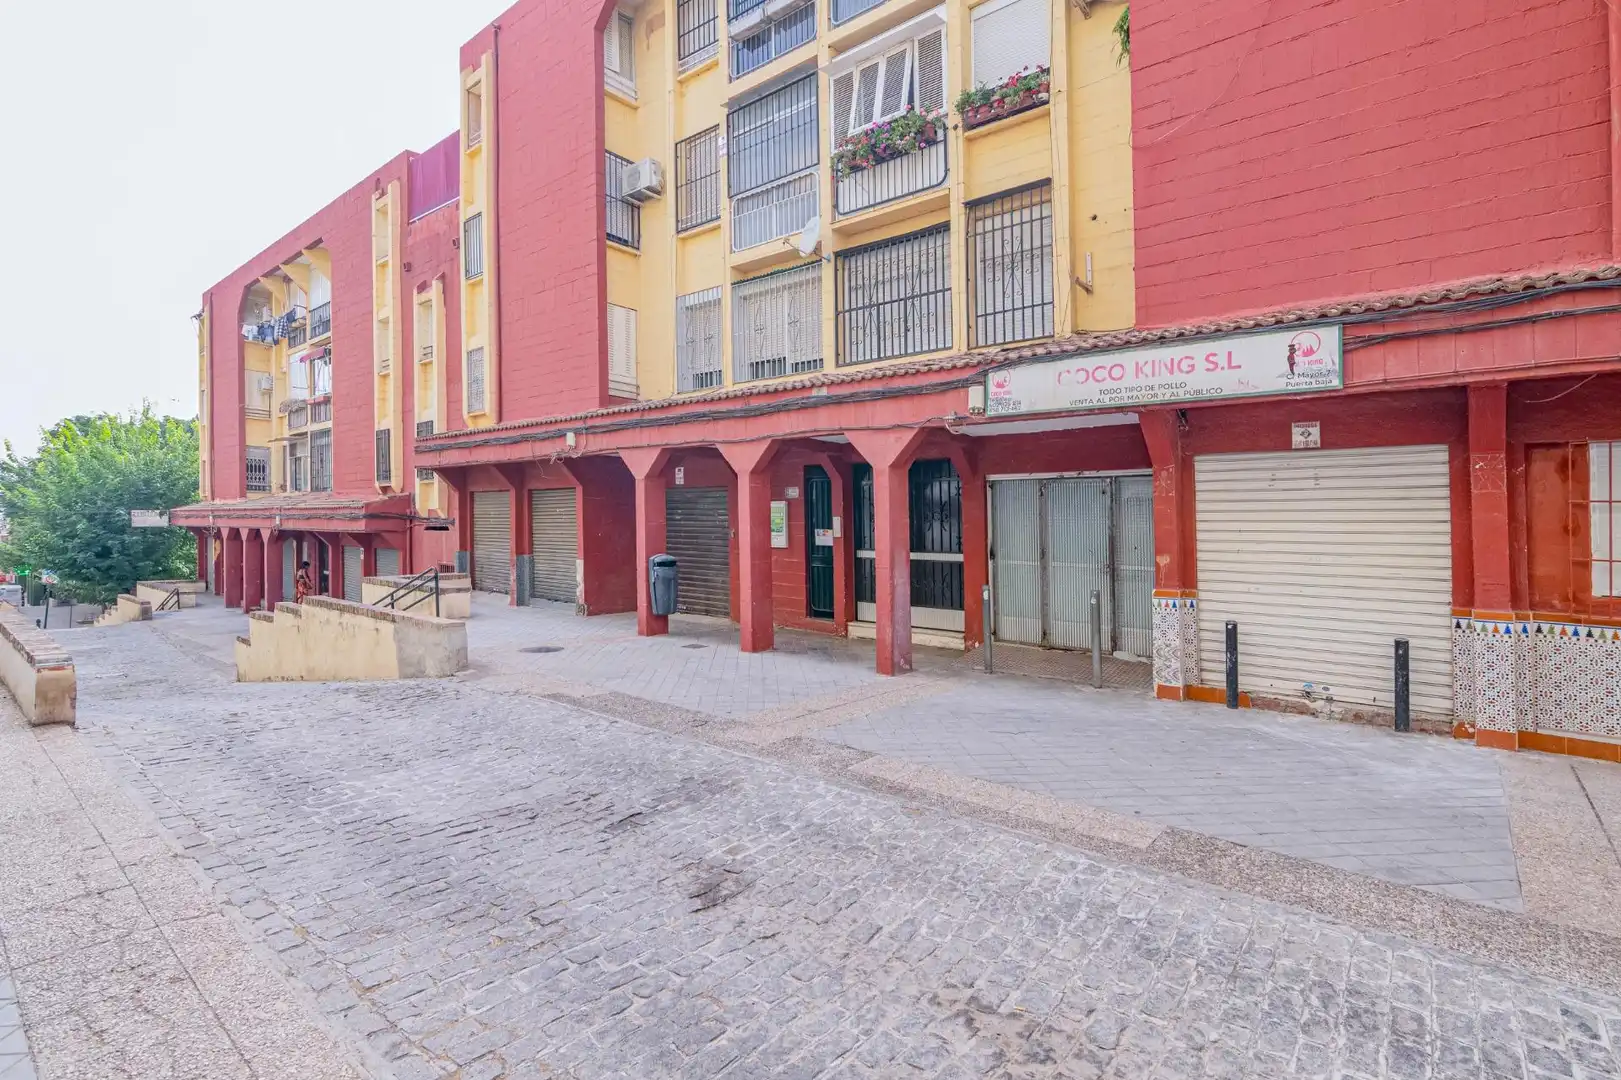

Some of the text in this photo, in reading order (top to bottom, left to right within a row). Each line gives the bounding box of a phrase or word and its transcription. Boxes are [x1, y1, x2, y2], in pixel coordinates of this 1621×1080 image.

[1135, 355, 1195, 379] KING
[1204, 350, 1242, 372] S.L
[1068, 386, 1224, 406] VENTA AL POR MAYOR Y AL PÚBLICO
[1098, 381, 1187, 396] TODO TIPO DE POLLO
